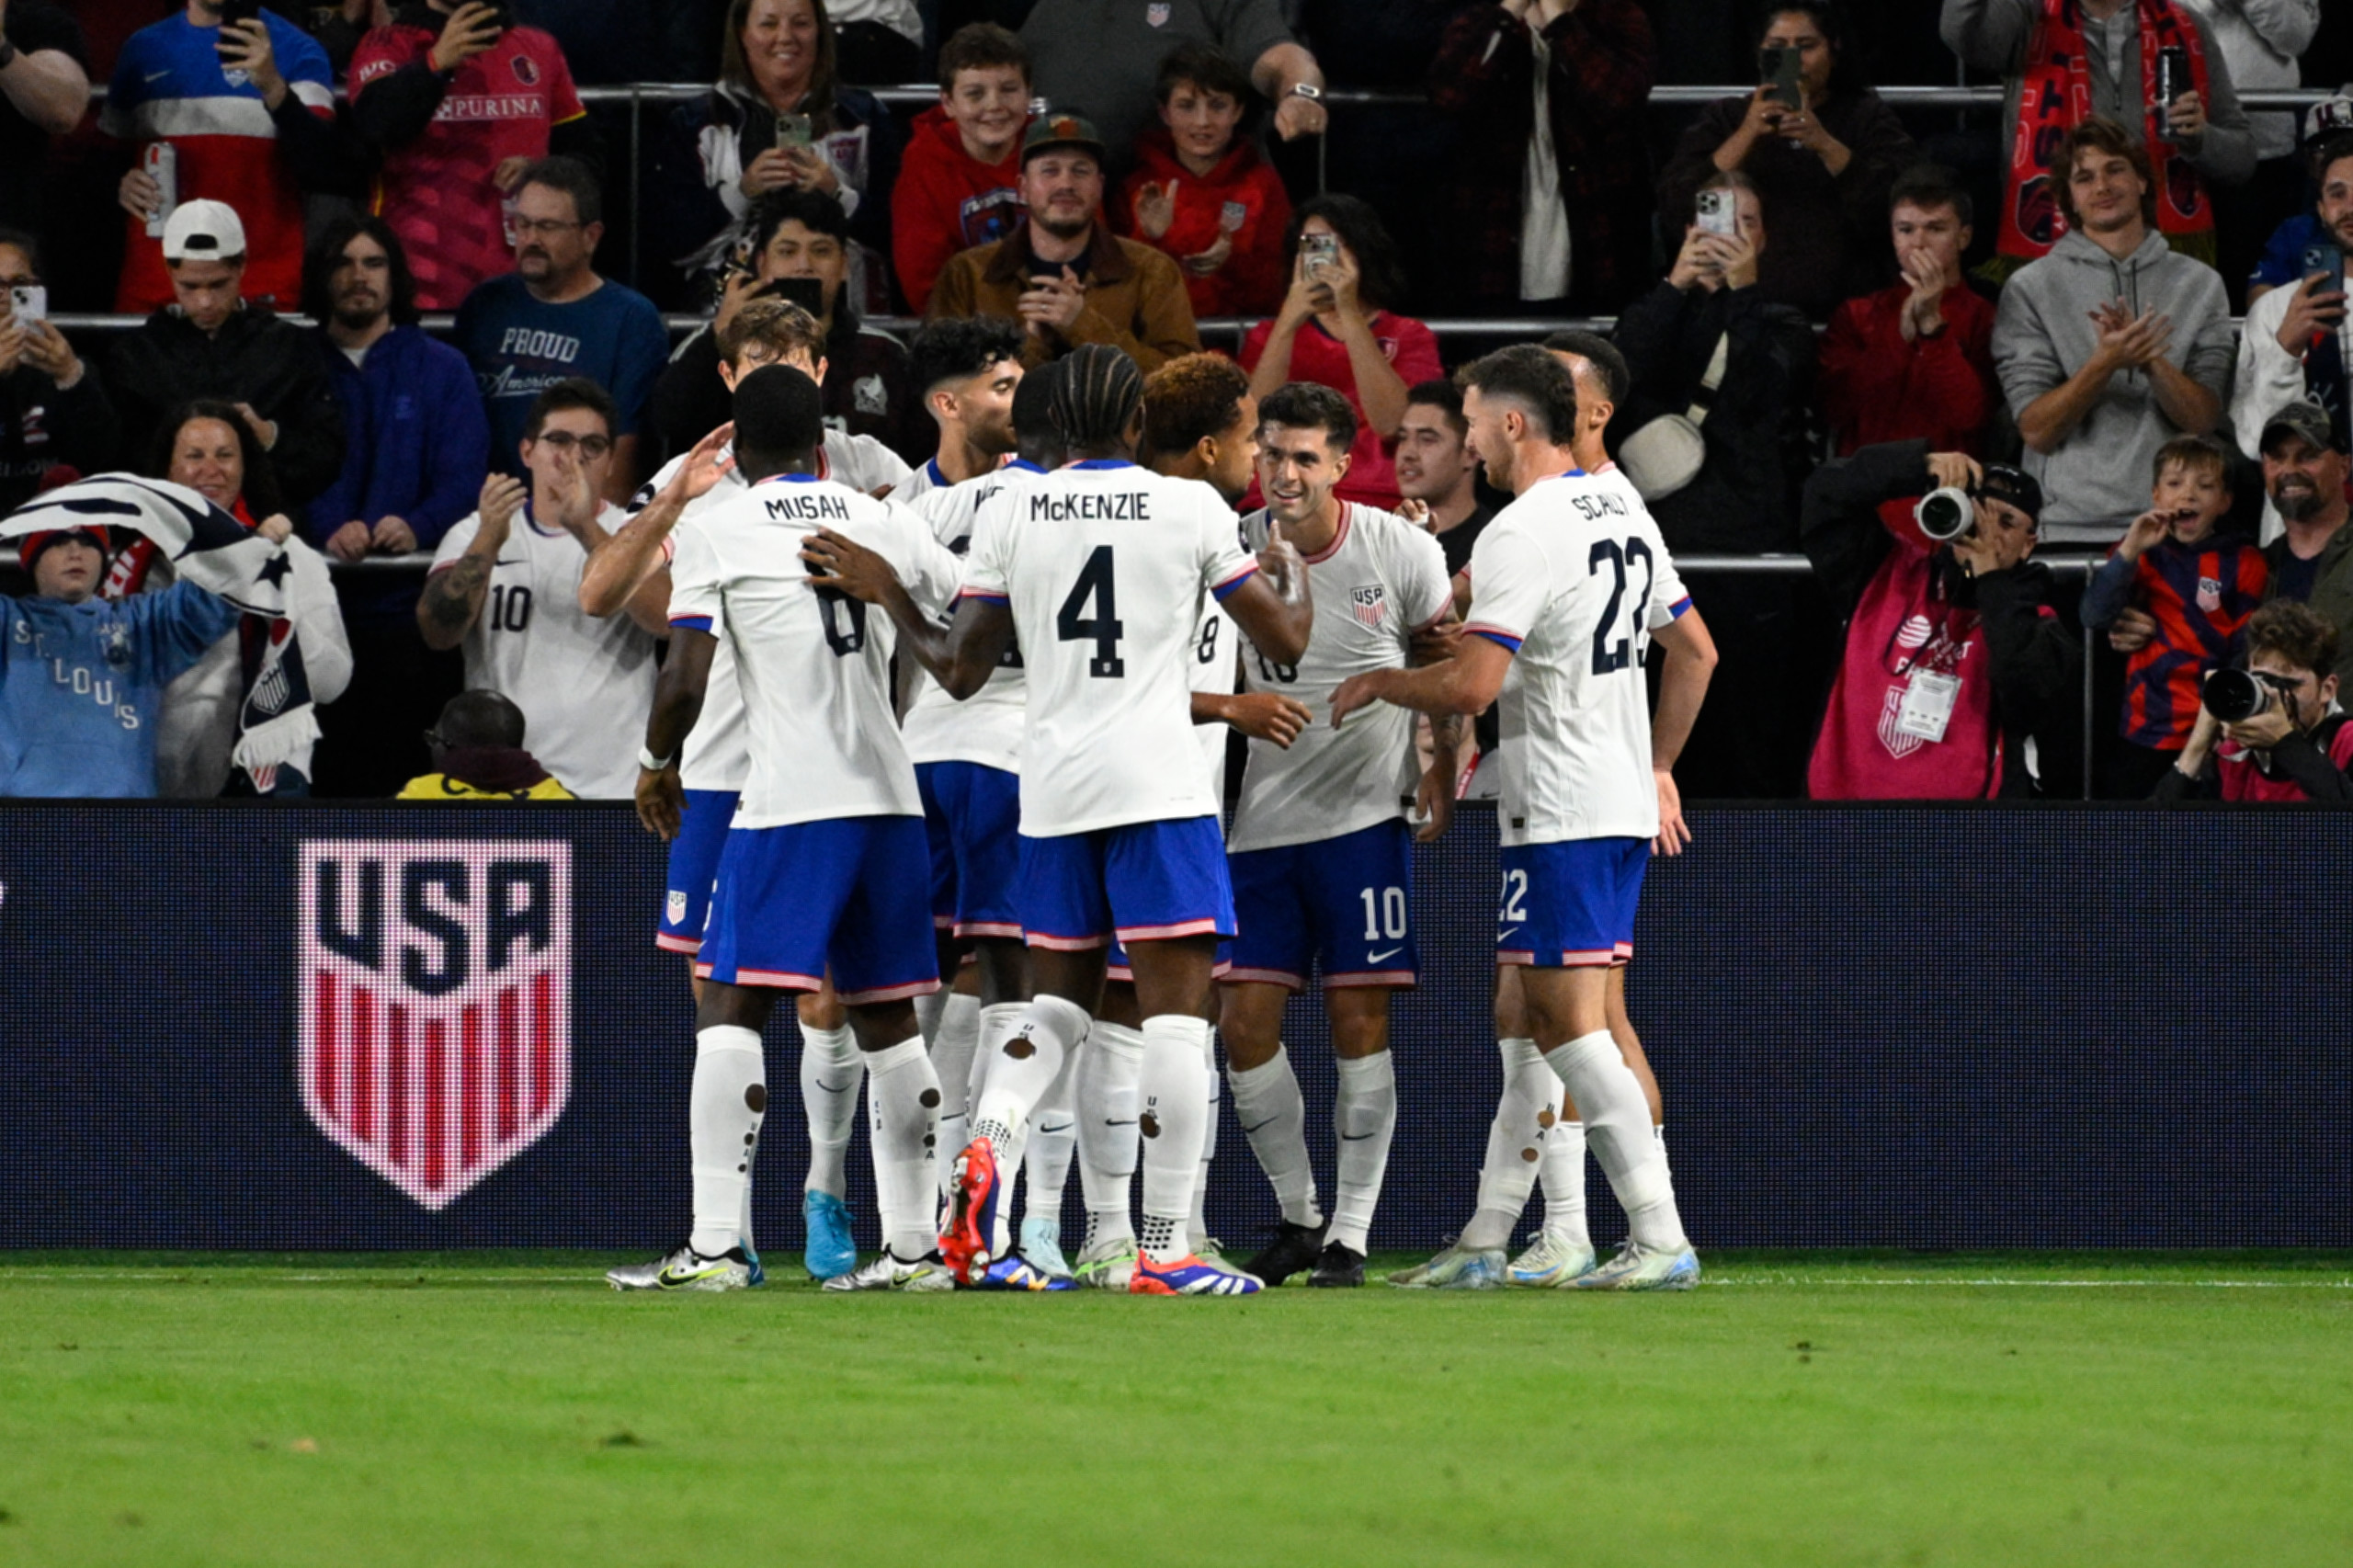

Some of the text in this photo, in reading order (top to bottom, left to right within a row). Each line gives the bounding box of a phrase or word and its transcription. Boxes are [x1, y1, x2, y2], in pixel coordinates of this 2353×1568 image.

[456, 98, 540, 117] PURINA
[499, 327, 581, 363] PROUD
[765, 494, 850, 521] MUSAH
[1030, 493, 1151, 521] McKENZIE
[491, 584, 532, 631] 10
[1057, 545, 1124, 678] 4
[1353, 587, 1383, 605] USA
[1588, 536, 1654, 676] 22
[1198, 615, 1219, 664] 8
[14, 619, 139, 729] ST. LOUIS
[316, 860, 551, 996] USA
[1360, 886, 1406, 940] 10
